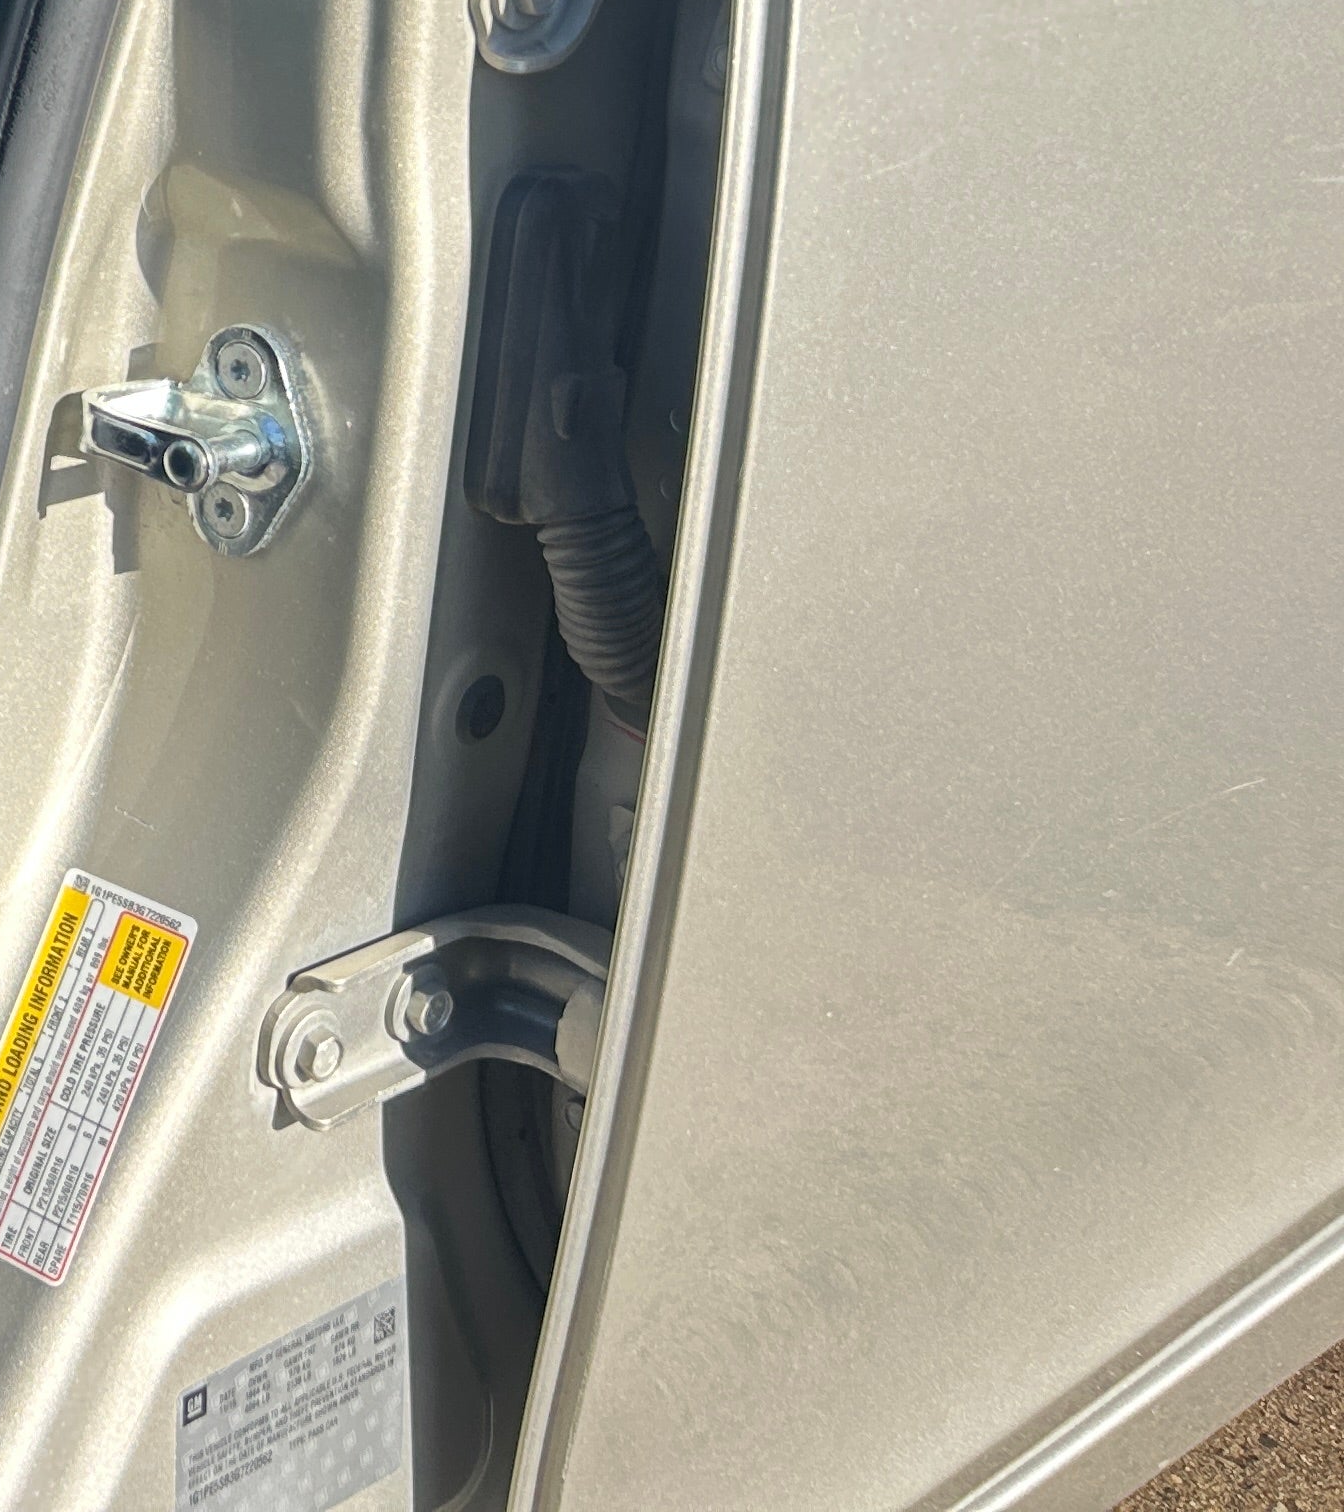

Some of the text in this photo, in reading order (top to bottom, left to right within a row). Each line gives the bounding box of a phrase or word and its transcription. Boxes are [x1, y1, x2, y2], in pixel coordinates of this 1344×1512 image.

[136, 928, 151, 950] FOR
[1, 1010, 38, 1078] LOADING
[27, 909, 79, 1013] INFORMATION
[59, 1001, 105, 1102] COLD TIRE PRESSURE
[22, 1064, 40, 1092] TOTAL
[22, 1125, 57, 1196] ORIGINAL SIZE
[0, 1225, 18, 1251] TIRE
[16, 1225, 37, 1259] FRONT
[32, 1239, 49, 1267] REAR
[47, 1242, 67, 1275] SPARE
